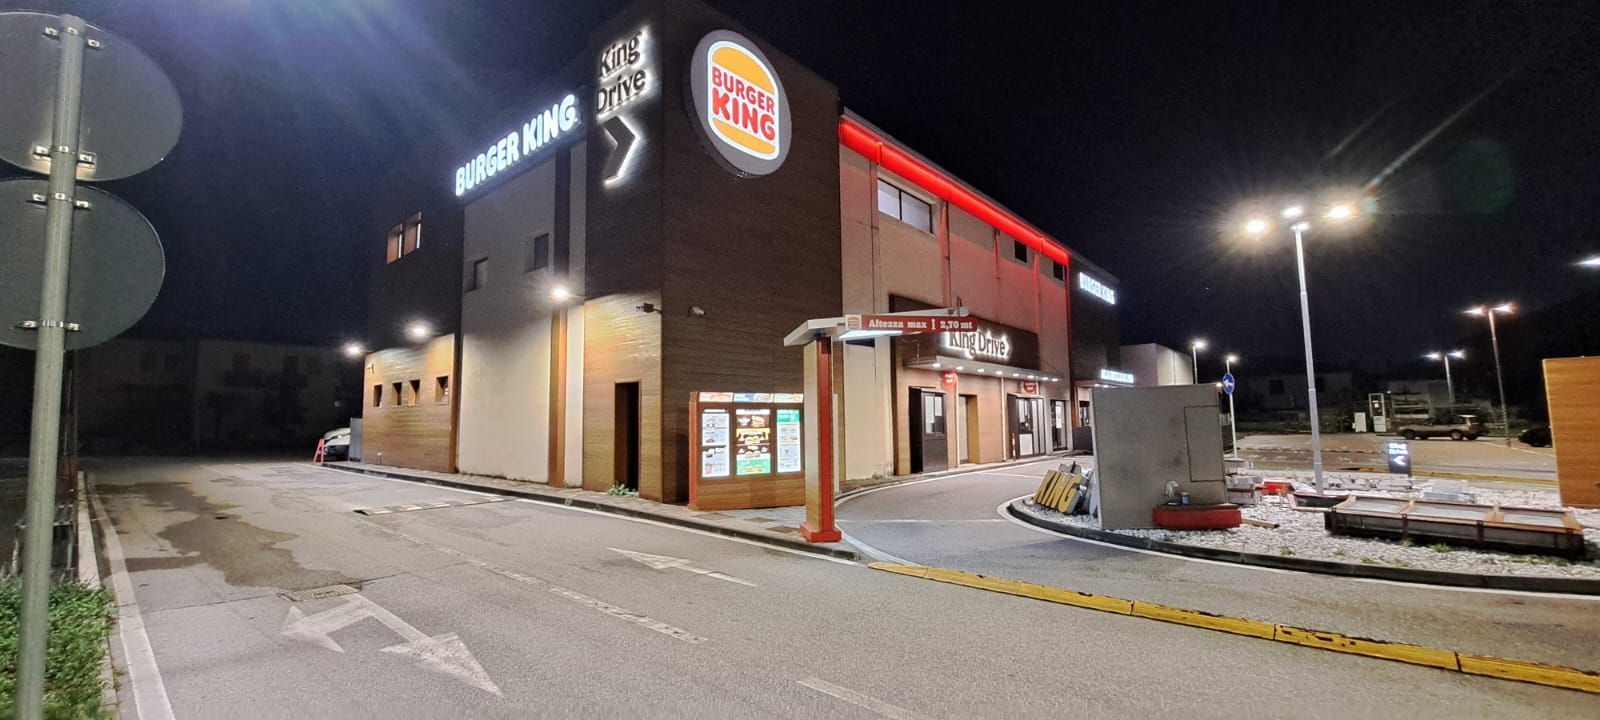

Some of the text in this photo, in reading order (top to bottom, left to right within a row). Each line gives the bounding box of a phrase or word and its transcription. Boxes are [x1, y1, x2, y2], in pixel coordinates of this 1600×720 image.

[599, 34, 640, 78] King
[596, 68, 646, 113] Drive
[711, 65, 775, 115] BURGER
[711, 87, 776, 141] KING
[455, 94, 577, 196] BURGER KING
[868, 319, 904, 329] Altezza
[907, 321, 927, 329] max
[940, 320, 960, 329] 2,70
[960, 320, 973, 329] mt
[949, 332, 1006, 355] King Drive
[1033, 469, 1082, 513] KING
